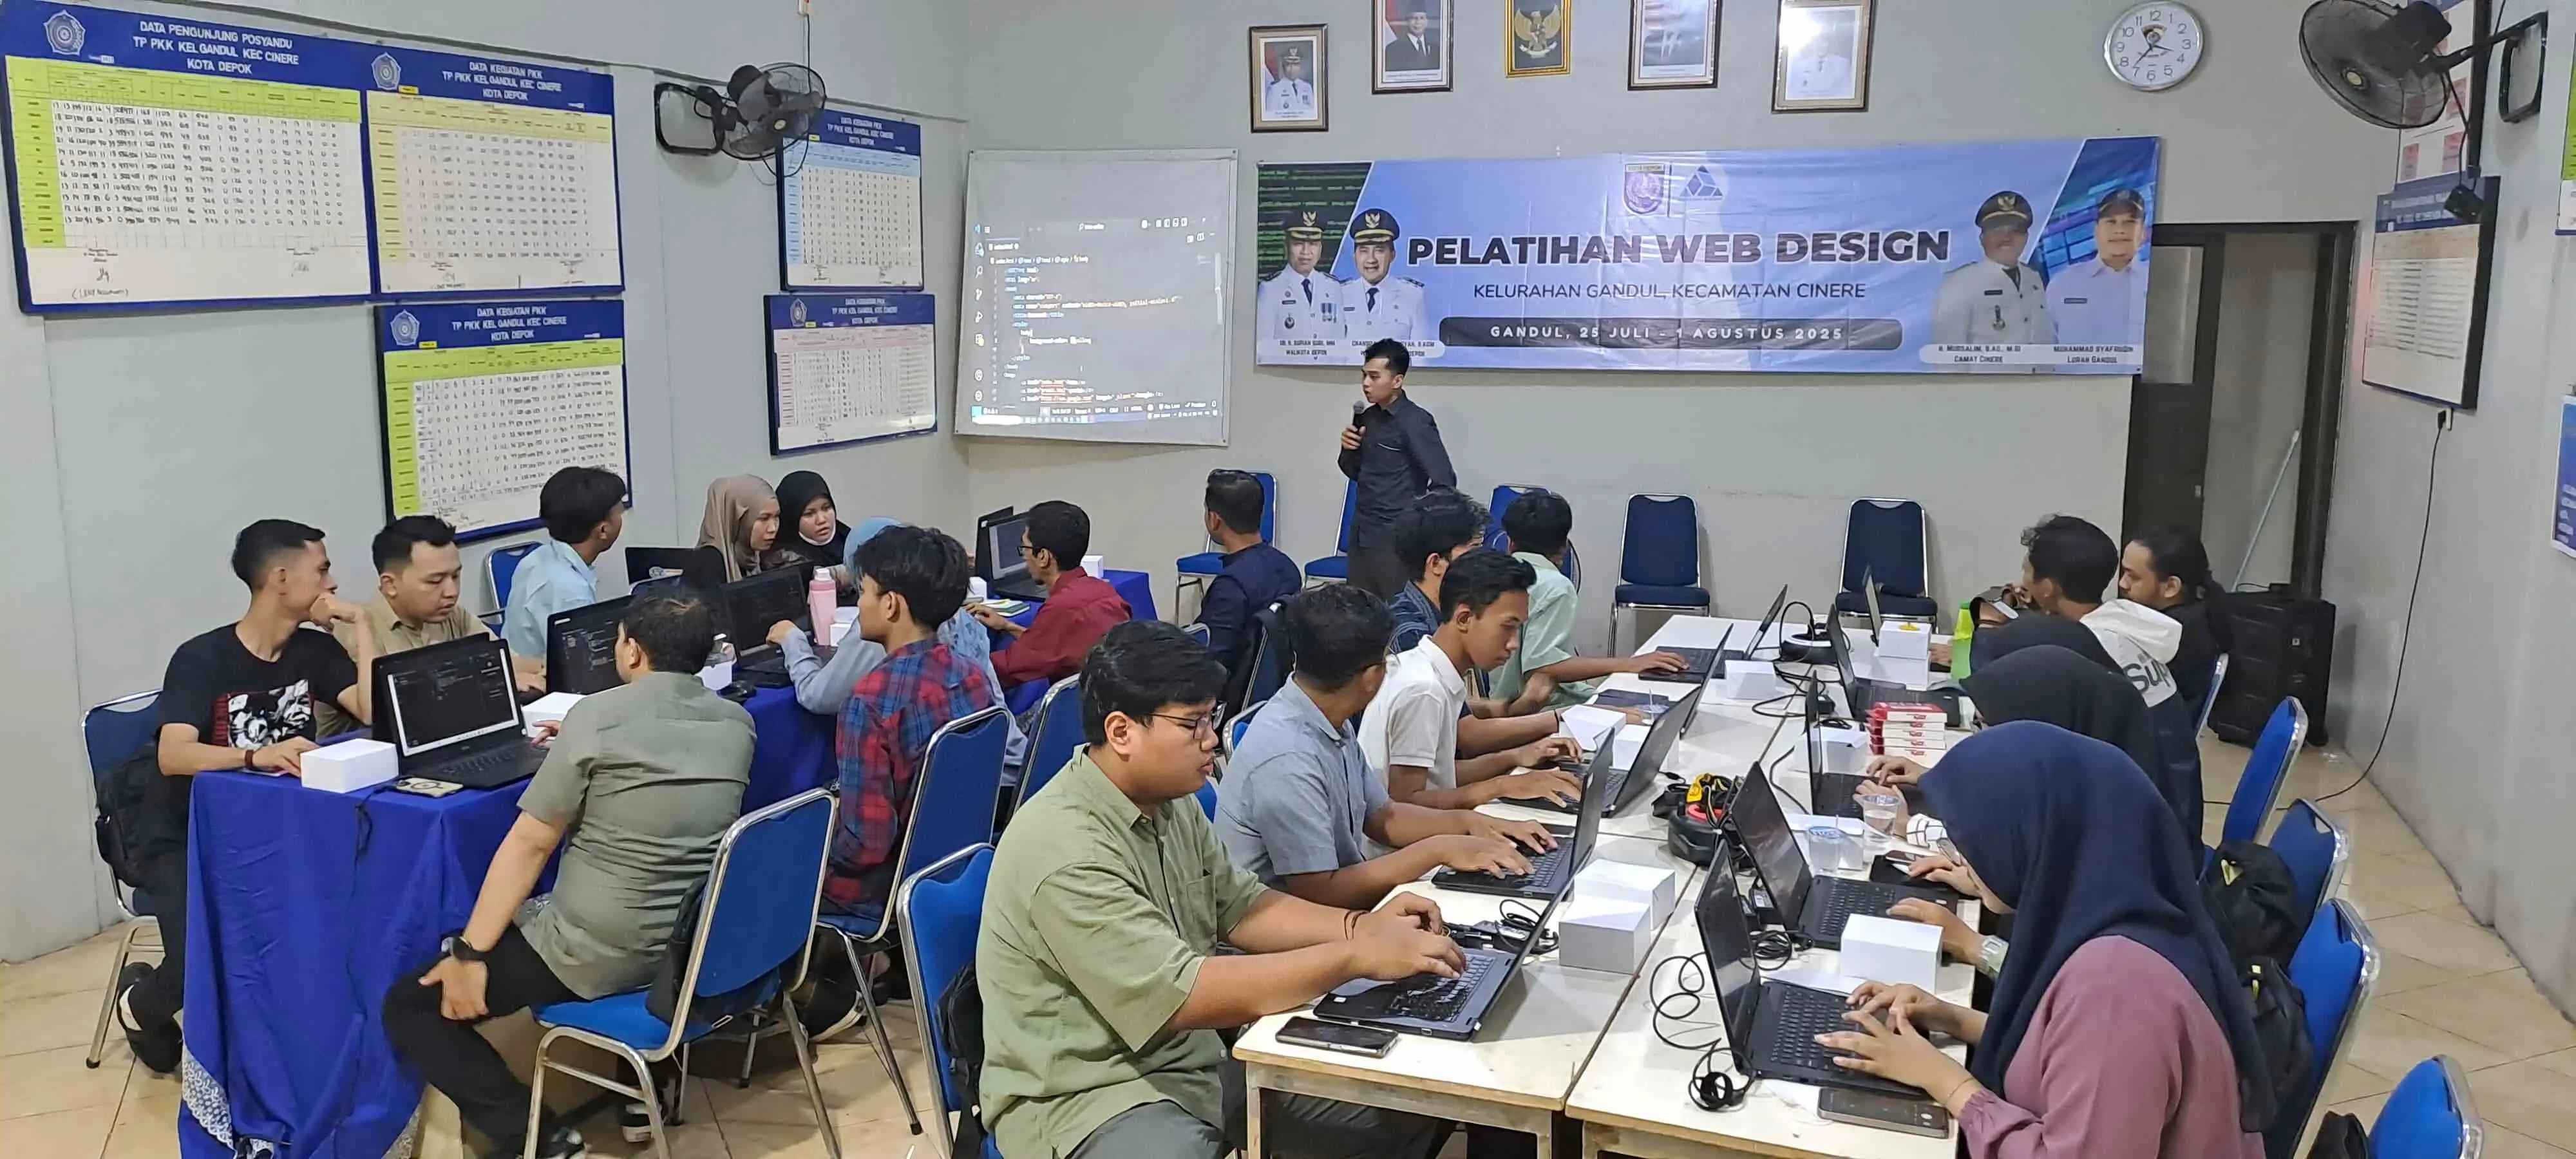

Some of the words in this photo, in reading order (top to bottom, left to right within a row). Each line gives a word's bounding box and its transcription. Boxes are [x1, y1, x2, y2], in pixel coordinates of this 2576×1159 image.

[2136, 16, 2142, 26] 11
[2150, 10, 2161, 21] 12
[2170, 13, 2173, 23] 1
[2123, 27, 2134, 37] 10
[2177, 23, 2187, 34] 2
[140, 21, 165, 33] DATA
[169, 24, 238, 42] PENGUNJUNG
[242, 33, 292, 49] POSYANDU
[2116, 42, 2125, 53] 9
[2182, 39, 2191, 50] 3
[133, 36, 147, 48] TP
[151, 39, 174, 50] PKK
[178, 41, 200, 53] KEL
[200, 44, 238, 57] GANDUL
[243, 48, 263, 60] KEC
[265, 51, 299, 65] CINERE
[2120, 57, 2129, 67] 8
[2177, 53, 2184, 63] 4
[187, 58, 215, 71] KOTA
[219, 62, 252, 75] DEPOK
[469, 62, 488, 72] DATA
[527, 69, 543, 79] PKK
[2133, 65, 2139, 77] 7
[2164, 65, 2173, 76] 5
[442, 71, 453, 81] TP
[455, 72, 471, 83] PKK
[474, 74, 489, 85] KEL
[489, 76, 518, 88] GANDUL
[520, 79, 535, 89] KEC
[2146, 70, 2155, 80] 6
[483, 88, 502, 98] KOTA
[504, 91, 528, 100] DEPOK
[1409, 234, 1641, 265] PELATIHAN
[1657, 233, 1761, 263] WEB
[1776, 230, 1949, 263] DESIGN
[1474, 285, 1580, 299] KELURAHAN
[1587, 284, 1666, 299] GANDUL,
[1672, 283, 1790, 298] KECAMATAN
[1797, 283, 1866, 297] CINERE
[477, 308, 495, 317] DATA
[497, 306, 529, 316] KEGIATAN
[532, 306, 547, 316] PKK
[452, 322, 462, 331] TP
[464, 321, 480, 330] PKK
[483, 319, 497, 330] KEL
[527, 317, 542, 327] KEC
[491, 332, 509, 342] KOTA
[1490, 326, 1570, 340] GANDUL,
[1580, 326, 1599, 338] 25
[1609, 326, 1649, 339] JULI
[1676, 328, 1682, 338] 1
[1692, 327, 1784, 339] AGUSTUS
[1794, 328, 1842, 340] 2025
